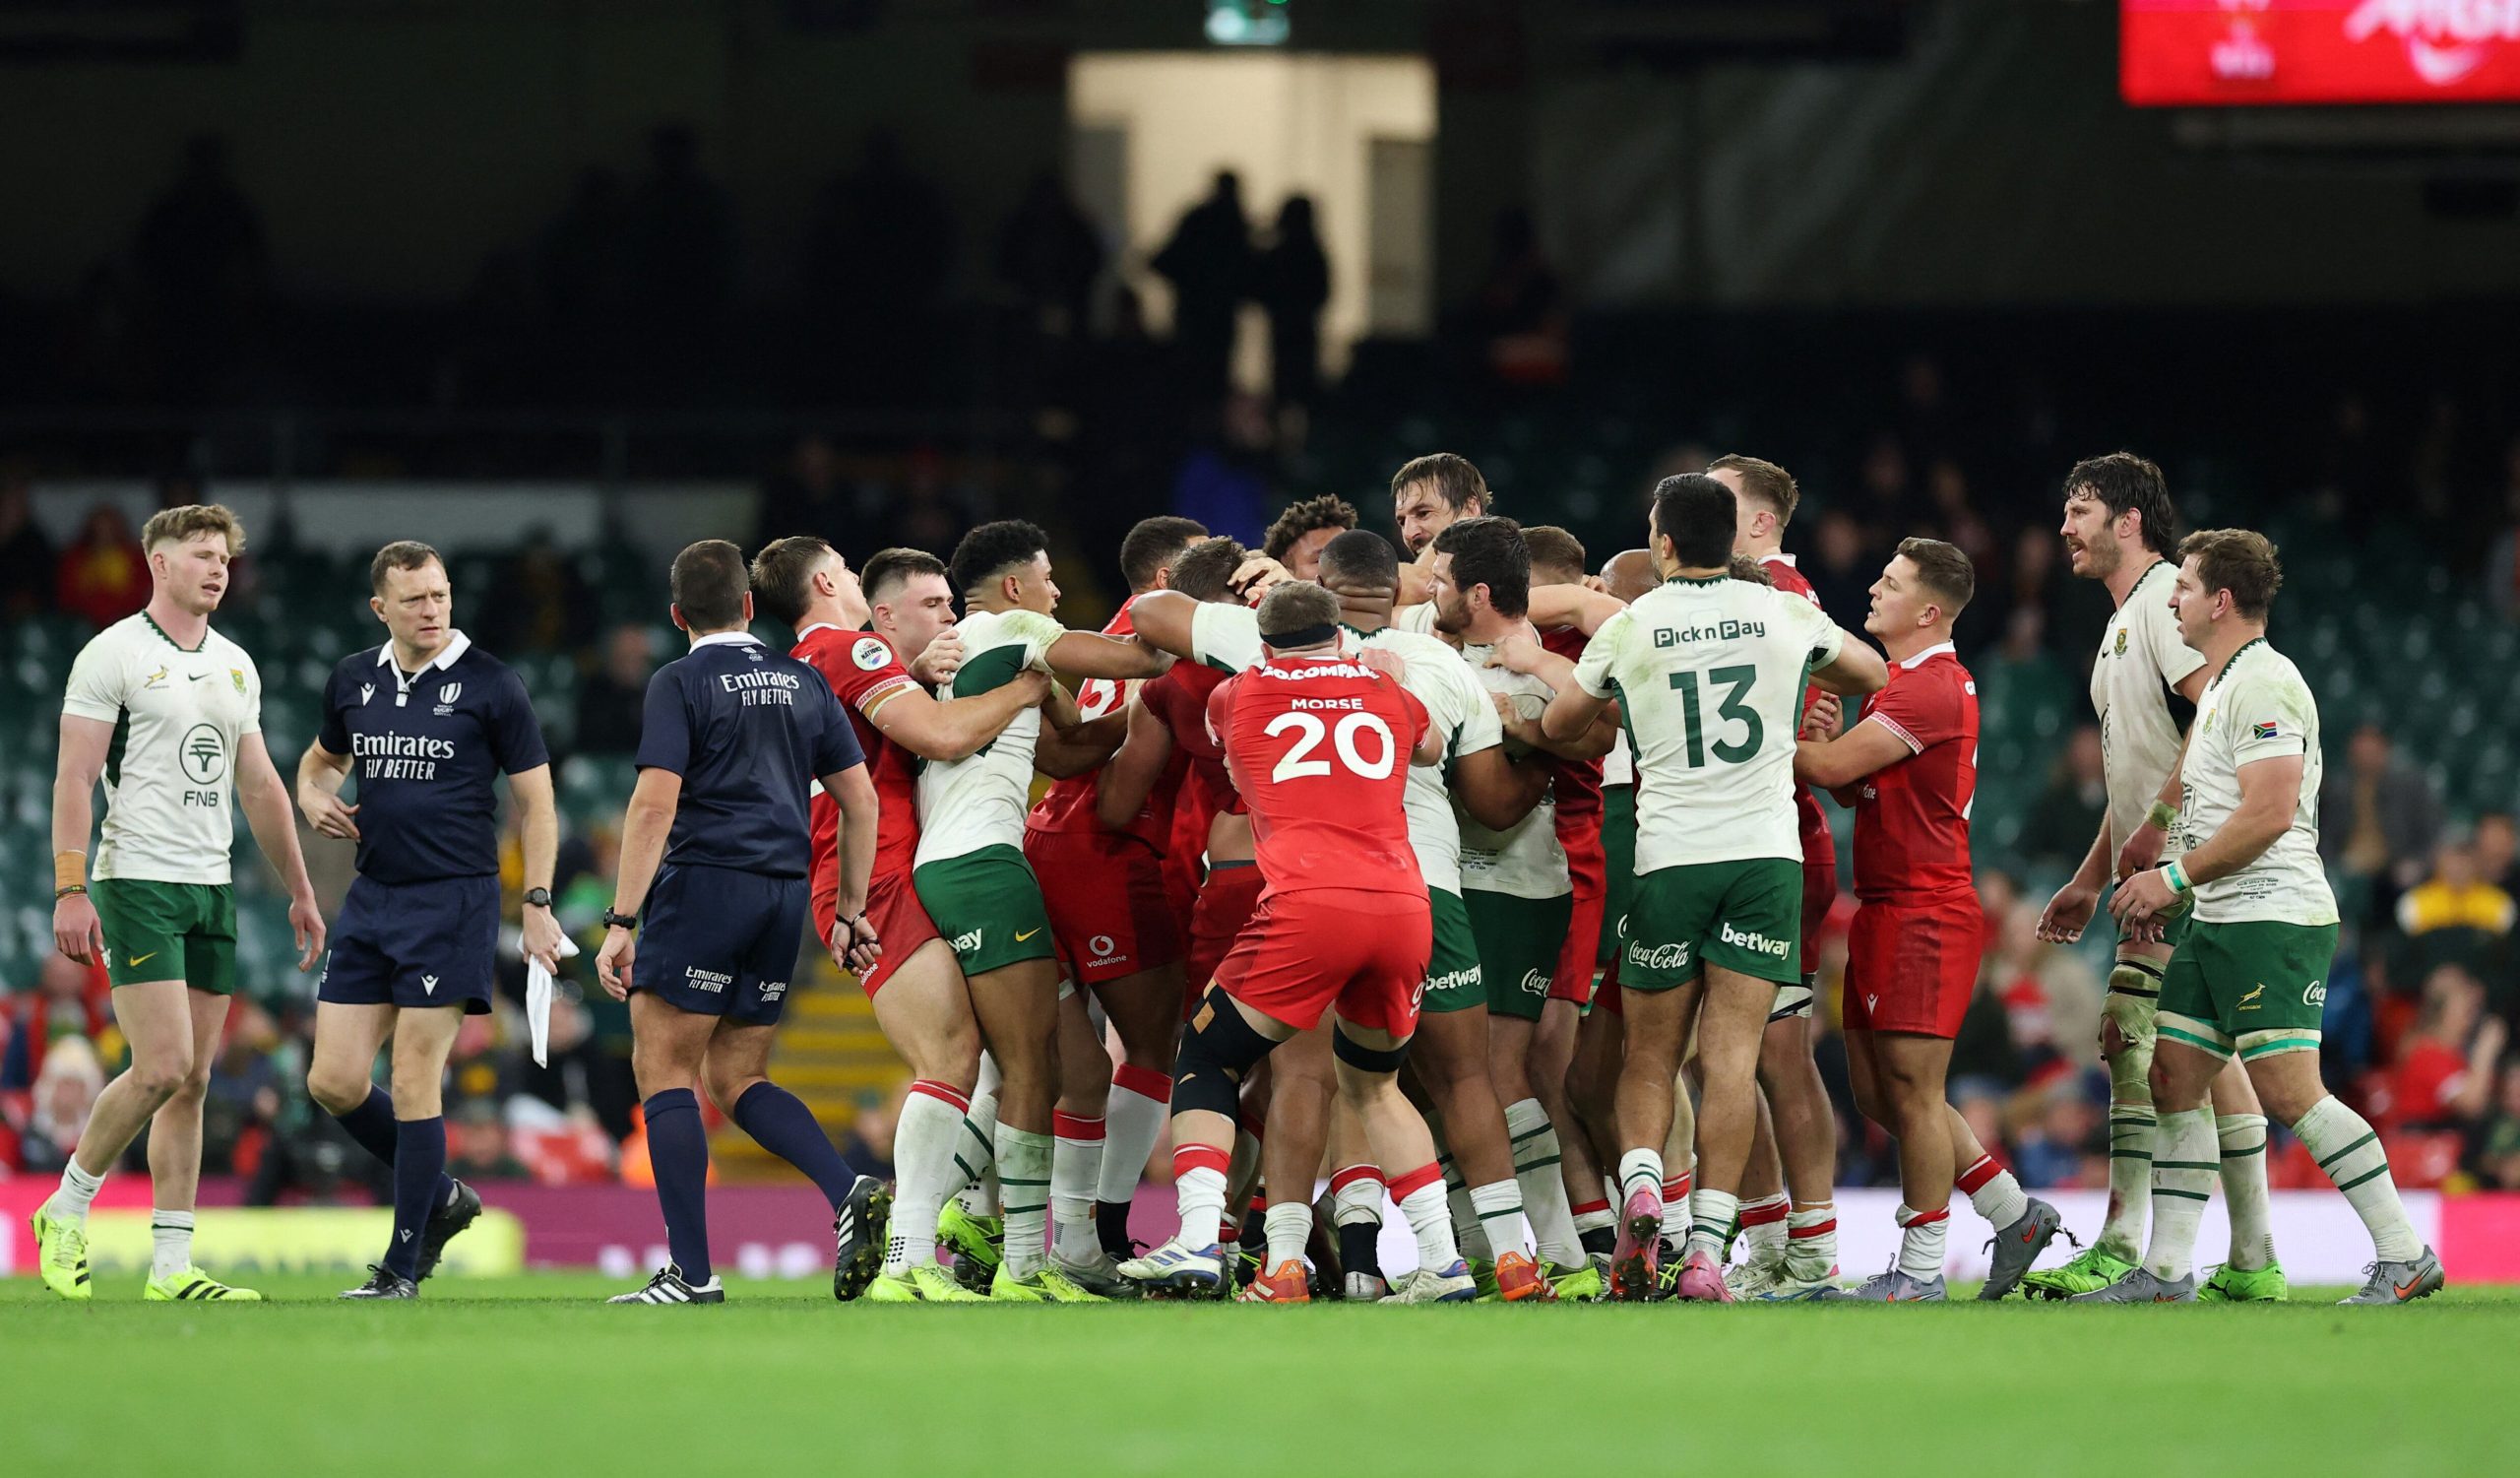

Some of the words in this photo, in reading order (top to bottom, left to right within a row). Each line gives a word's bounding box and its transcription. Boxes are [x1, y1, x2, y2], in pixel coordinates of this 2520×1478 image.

[720, 668, 800, 693] Emirates
[741, 689, 757, 706] FLY
[760, 688, 793, 706] BETTER
[1292, 698, 1364, 710] MORSE
[1670, 664, 1764, 769] 13
[352, 730, 455, 759] Emirates
[1263, 711, 1396, 784] 20
[365, 758, 383, 779] FLY
[383, 758, 436, 781] BETTER
[183, 791, 219, 807] FNB
[1628, 939, 1693, 969] Coca-Cola
[1721, 922, 1792, 961] betway
[1086, 955, 1127, 968] vodafone
[685, 965, 733, 985] Emirates
[1424, 963, 1481, 992] betway
